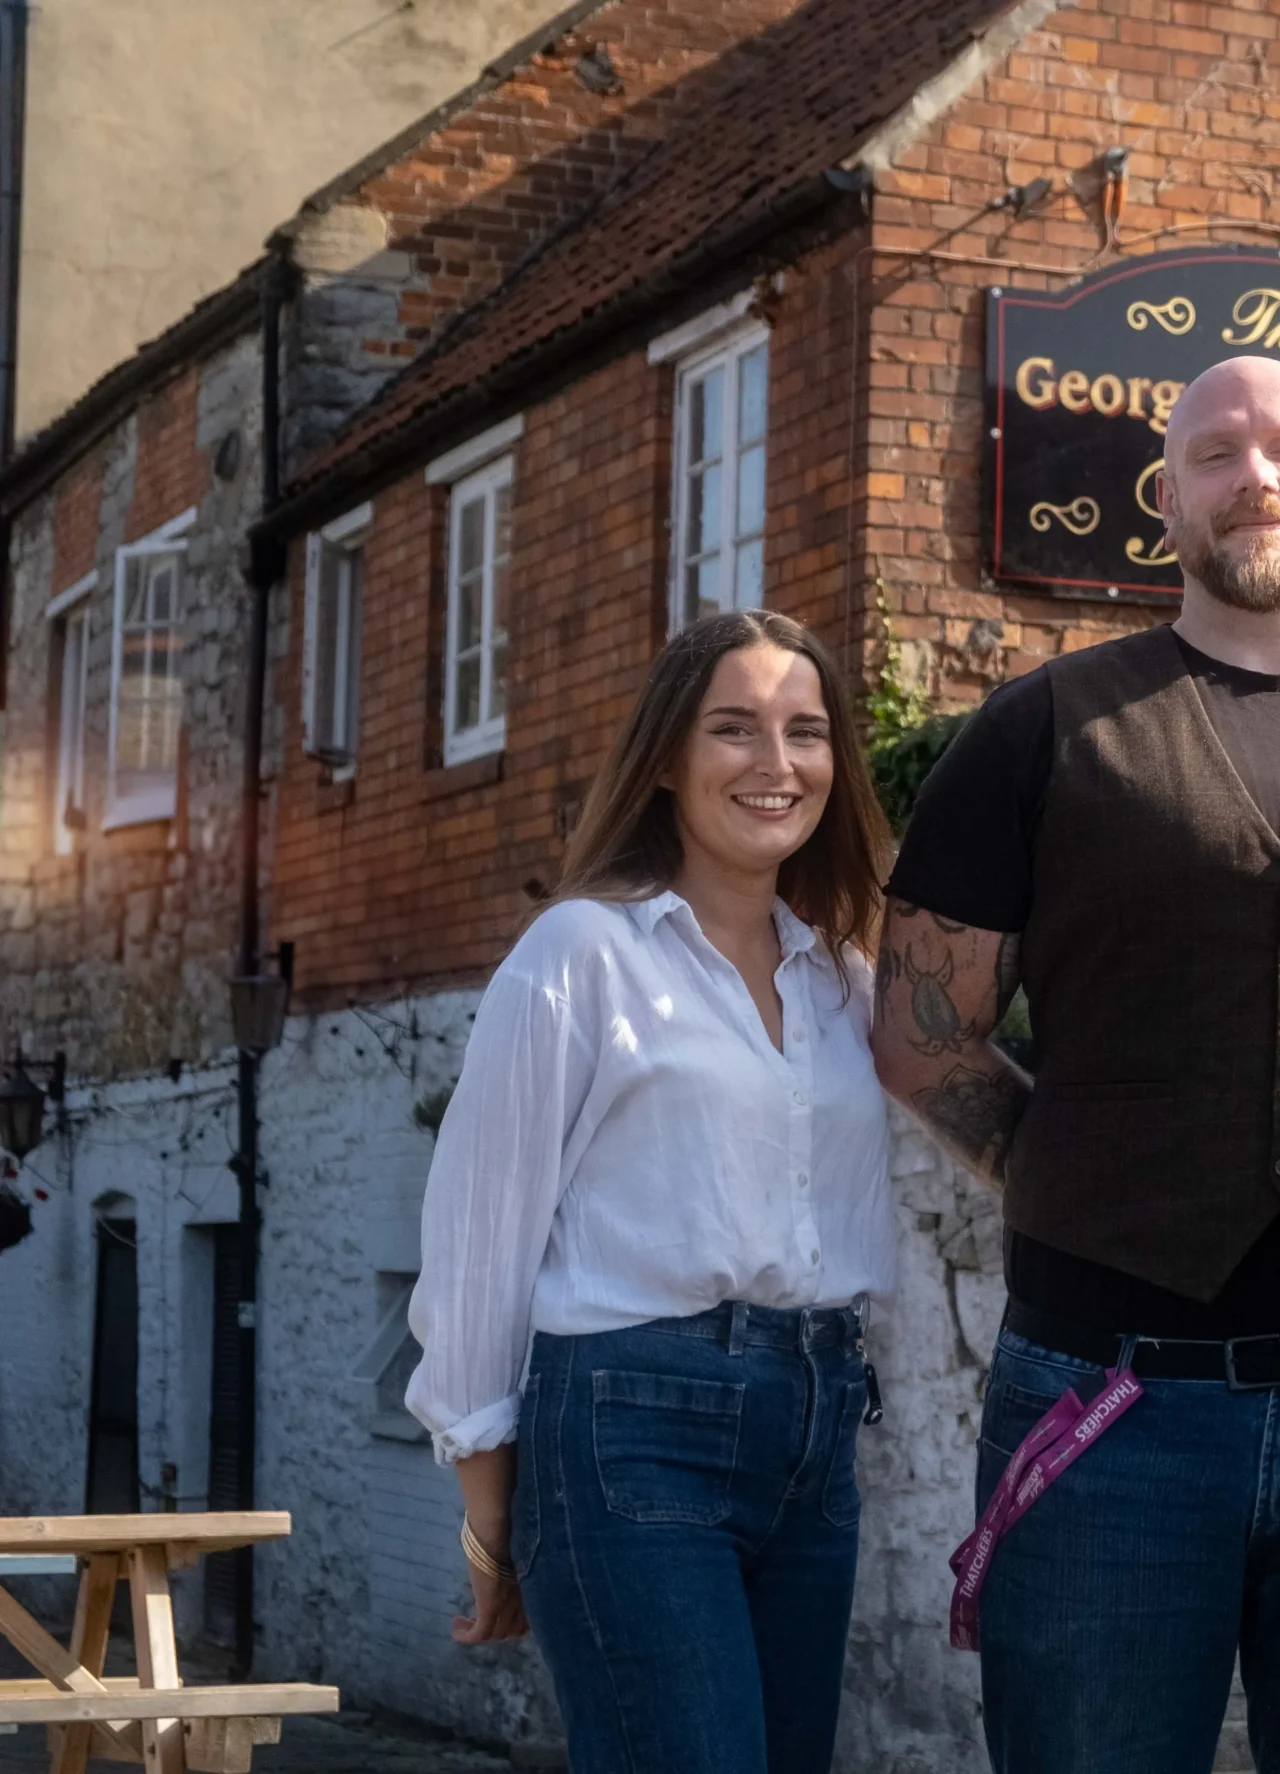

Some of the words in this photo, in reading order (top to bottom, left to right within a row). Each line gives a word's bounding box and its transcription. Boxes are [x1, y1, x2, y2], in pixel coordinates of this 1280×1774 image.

[1016, 357, 1188, 435] Georg
[1075, 1379, 1139, 1442] THATCHERS
[959, 1526, 993, 1598] THATCHERS
